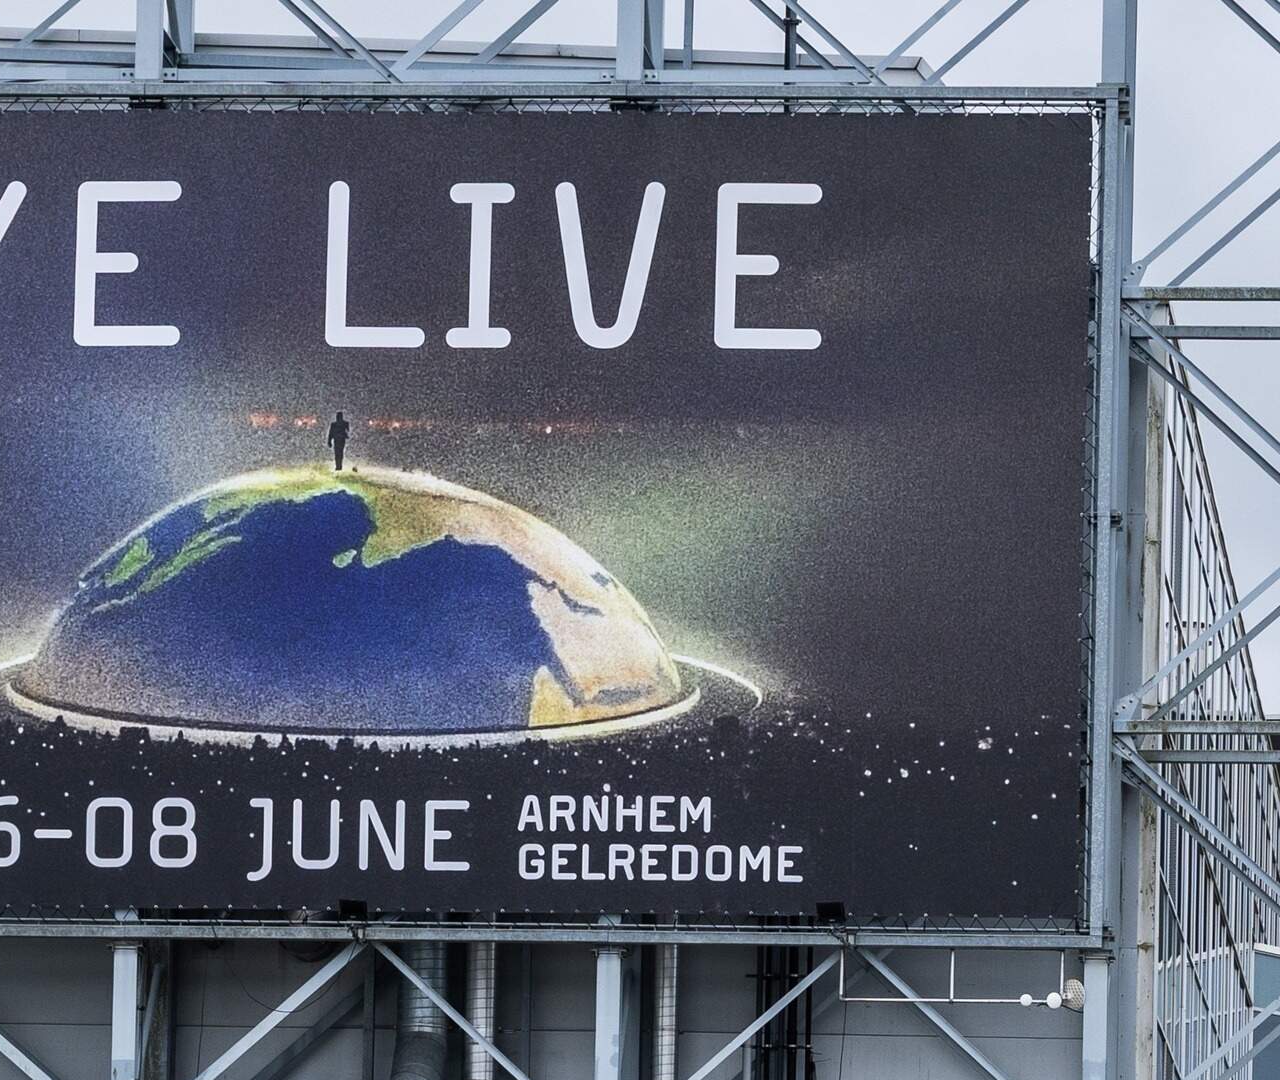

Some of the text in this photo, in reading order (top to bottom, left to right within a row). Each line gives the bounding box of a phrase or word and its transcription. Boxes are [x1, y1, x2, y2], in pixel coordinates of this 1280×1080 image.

[324, 180, 824, 351] LIVE
[246, 798, 470, 882] JUNE
[517, 795, 713, 833] ARNHEM
[518, 843, 805, 883] GELREDOME
